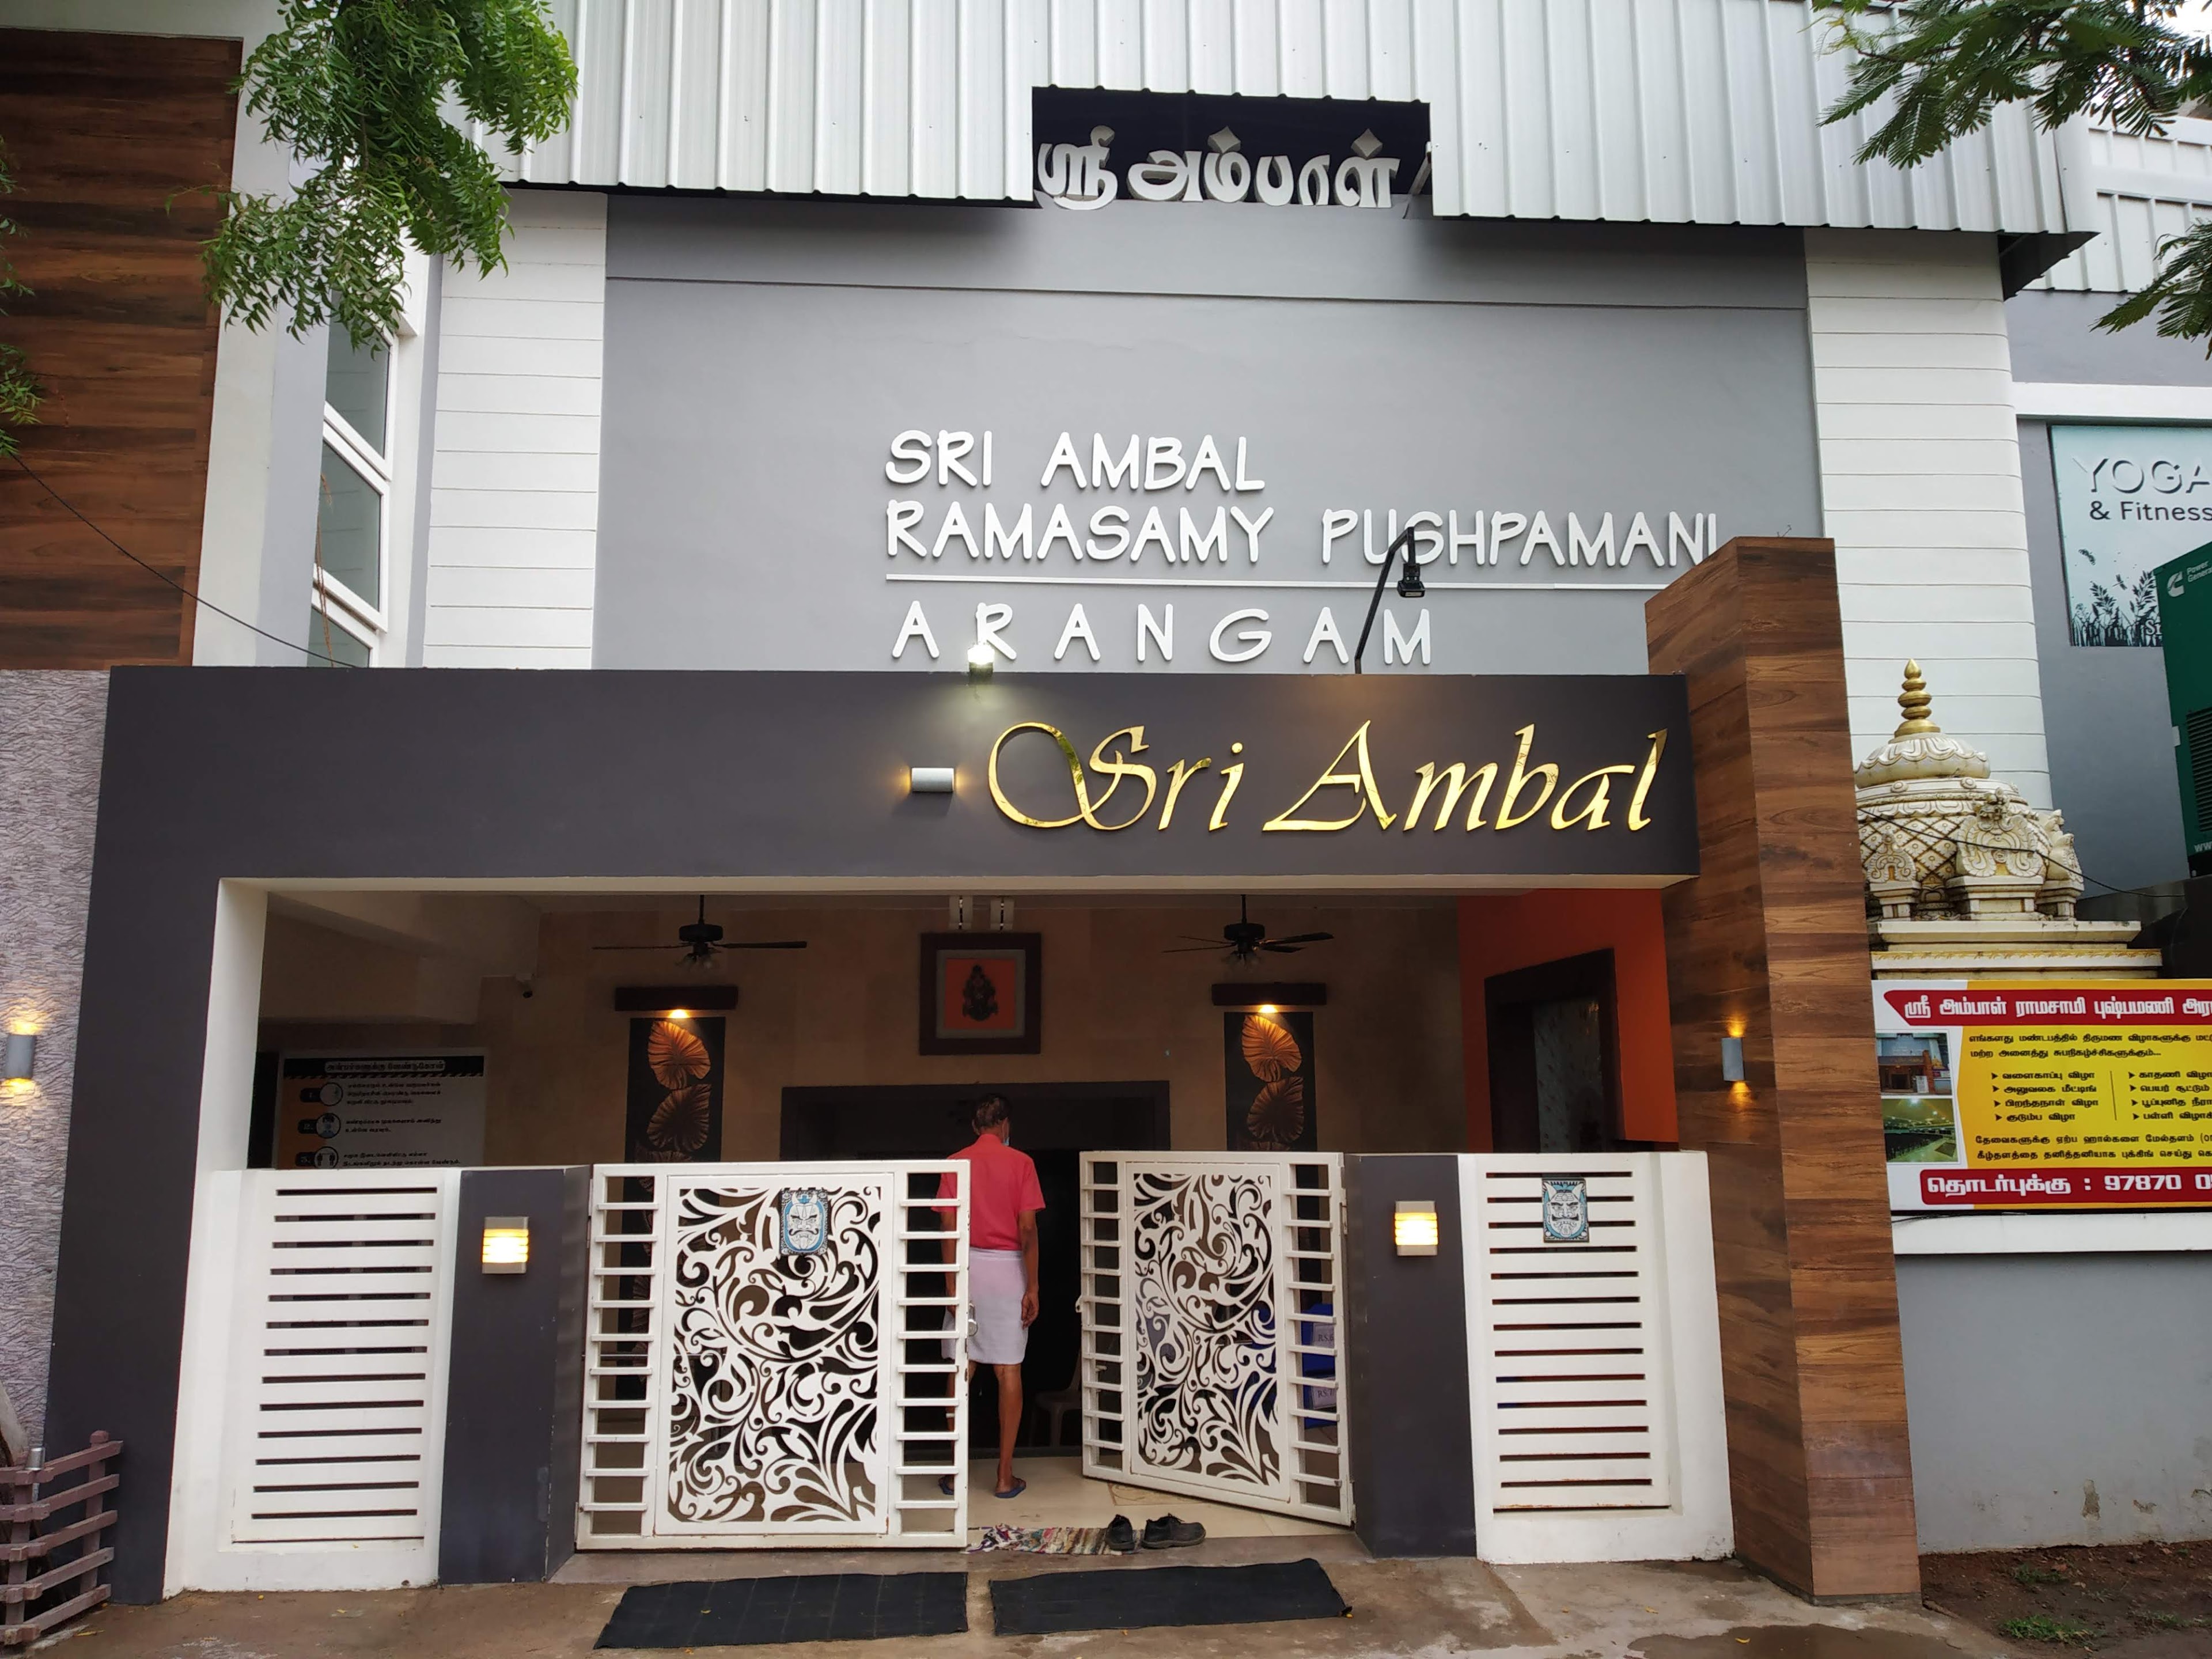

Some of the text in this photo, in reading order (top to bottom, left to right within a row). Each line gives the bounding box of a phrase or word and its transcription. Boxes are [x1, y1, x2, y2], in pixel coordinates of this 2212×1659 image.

[1126, 125, 1400, 209] அம்பாள்
[885, 429, 1266, 491] SRI AMBAL
[2073, 455, 2212, 494] YOGA
[2090, 500, 2212, 521] & Fitness
[886, 498, 1717, 566] RAMASAMY PUSHPAMANI
[2187, 560, 2210, 575] Power
[892, 600, 1431, 665] ARANGAM
[987, 718, 1666, 832] Sri Ambal
[1940, 996, 2006, 1015] அம்பாள்
[2016, 997, 2086, 1017] ராமசாமி
[2094, 996, 2175, 1019] புஷ்பமணி
[2182, 998, 2212, 1017] அர
[1969, 1034, 2014, 1044] எங்களது
[2019, 1033, 2077, 1043] மண்டபத்தில்
[2082, 1033, 2123, 1043] திருமண
[1971, 1049, 1994, 1058] மற்ற
[1999, 1048, 2048, 1059] அனைத்து
[2002, 1071, 2095, 1081] வளைகாப்பு விழா
[2139, 1071, 2181, 1080] காதணி
[2061, 1084, 2097, 1094] மீட்டிங்
[2140, 1084, 2210, 1093] பெயர் சூட்டும்
[2005, 1099, 2099, 1108] பிறந்தநாள் விழா
[2142, 1098, 2187, 1108] பூப்புனித
[2006, 1112, 2075, 1122] குடும்ப விழா
[2143, 1111, 2174, 1120] பள்ளி
[1975, 1135, 2051, 1145] தேவைகளுக்கு
[2056, 1135, 2078, 1144] ஏற்ப
[2083, 1134, 2139, 1145] ஹால்களை
[2145, 1134, 2195, 1143] மேல்தளம்
[1977, 1150, 2038, 1161] கீழ்தளத்தை
[2043, 1149, 2116, 1160] தனித்தனியாக
[2122, 1149, 2154, 1160] புக்கிங்
[2160, 1149, 2192, 1160] செய்து
[1927, 1173, 2071, 1198] தொடர்புக்கு
[2104, 1175, 2181, 1191] 97870
[2195, 1174, 2212, 1190] 0
